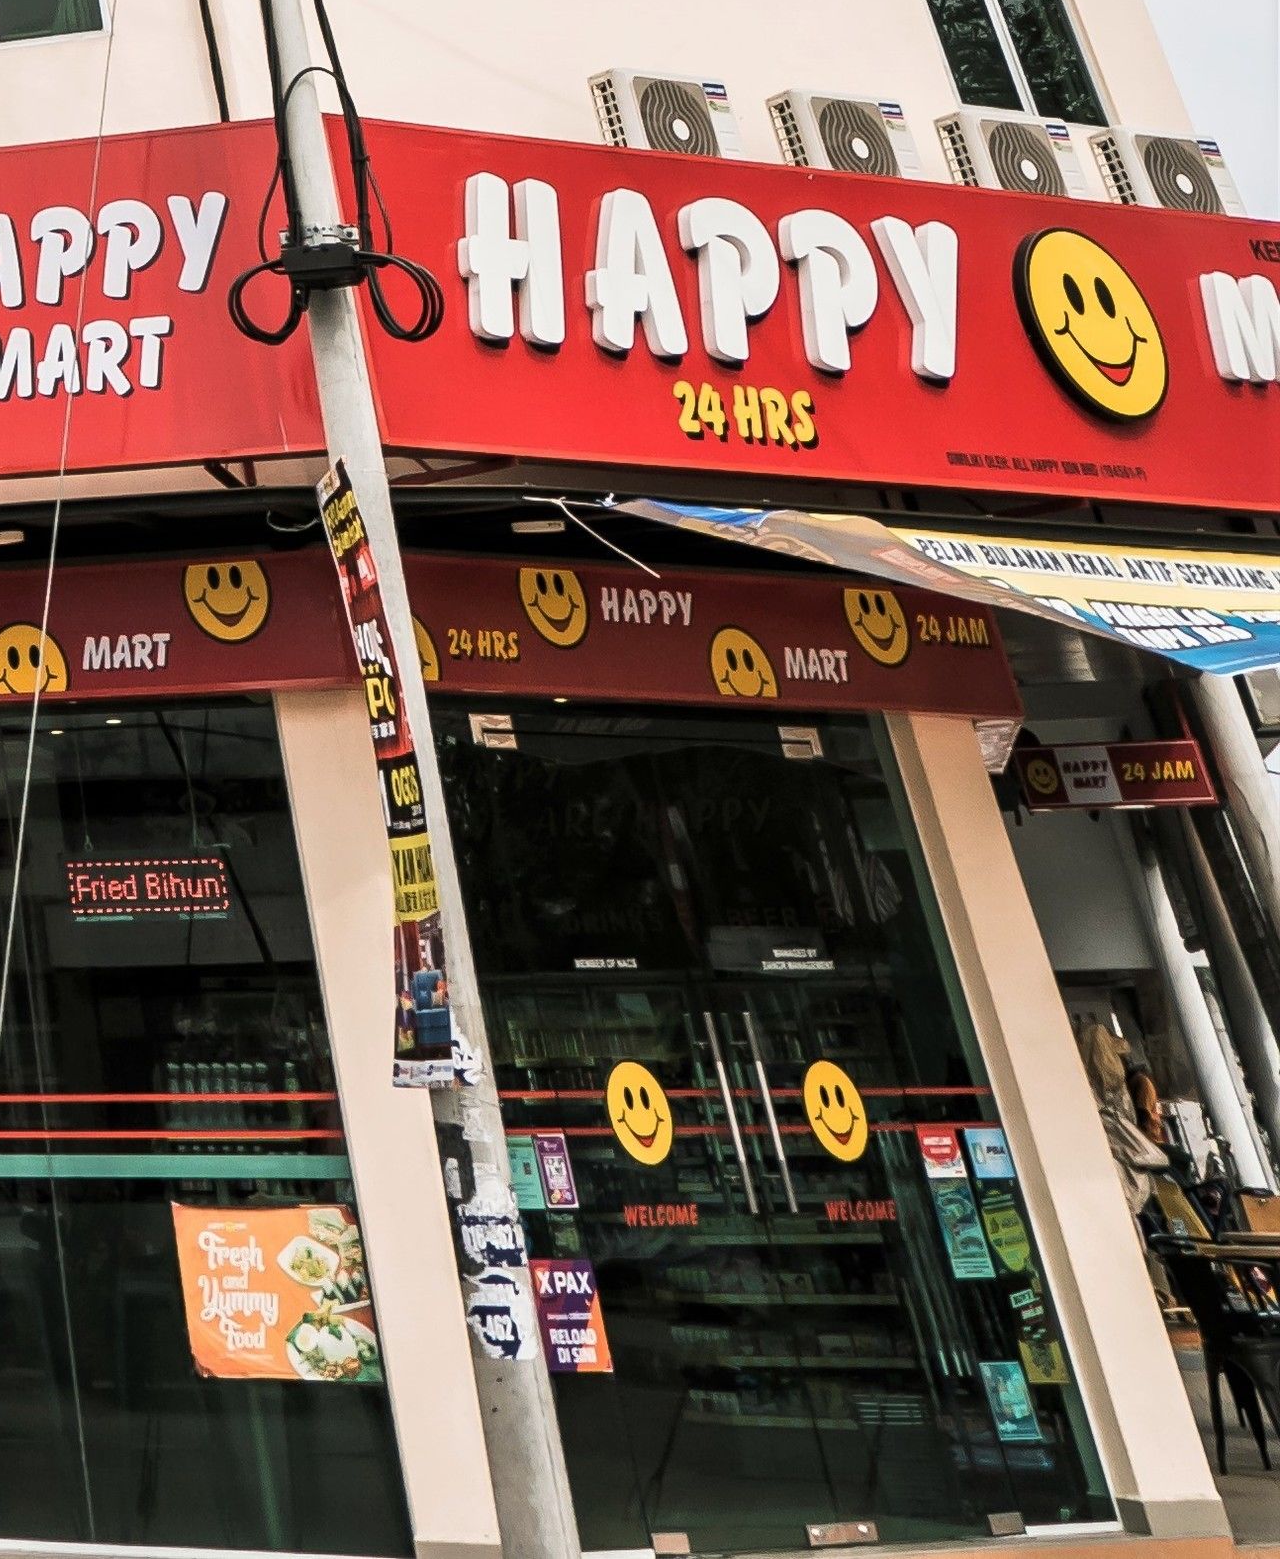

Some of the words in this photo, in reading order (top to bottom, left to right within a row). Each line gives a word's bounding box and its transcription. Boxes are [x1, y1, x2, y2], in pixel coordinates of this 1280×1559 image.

[457, 170, 960, 380] HAPPY
[674, 381, 726, 438] 24
[733, 383, 821, 449] HRS
[914, 538, 978, 564] PELAN
[978, 545, 1064, 573] BULANAN
[1062, 552, 1122, 579] KEKAL
[1122, 558, 1172, 583] AKTIF
[1175, 563, 1274, 591] SEPANJANG
[600, 585, 694, 627] HAPPY
[446, 628, 476, 659] 24
[476, 629, 520, 663] HRS
[915, 613, 942, 644] 24
[945, 615, 990, 646] JAM
[81, 633, 171, 673] MART
[783, 646, 849, 683] MART
[1151, 760, 1195, 780] JAM
[75, 874, 137, 901] Fried
[144, 872, 220, 900] Bihun
[624, 1204, 698, 1227] WELCOME
[825, 1200, 897, 1222] WELCOME
[197, 1230, 266, 1273] Fresh
[197, 1274, 280, 1326] Yummy
[218, 1316, 266, 1351] Food
[549, 1328, 598, 1346] RELOAD
[557, 1347, 572, 1364] DI
